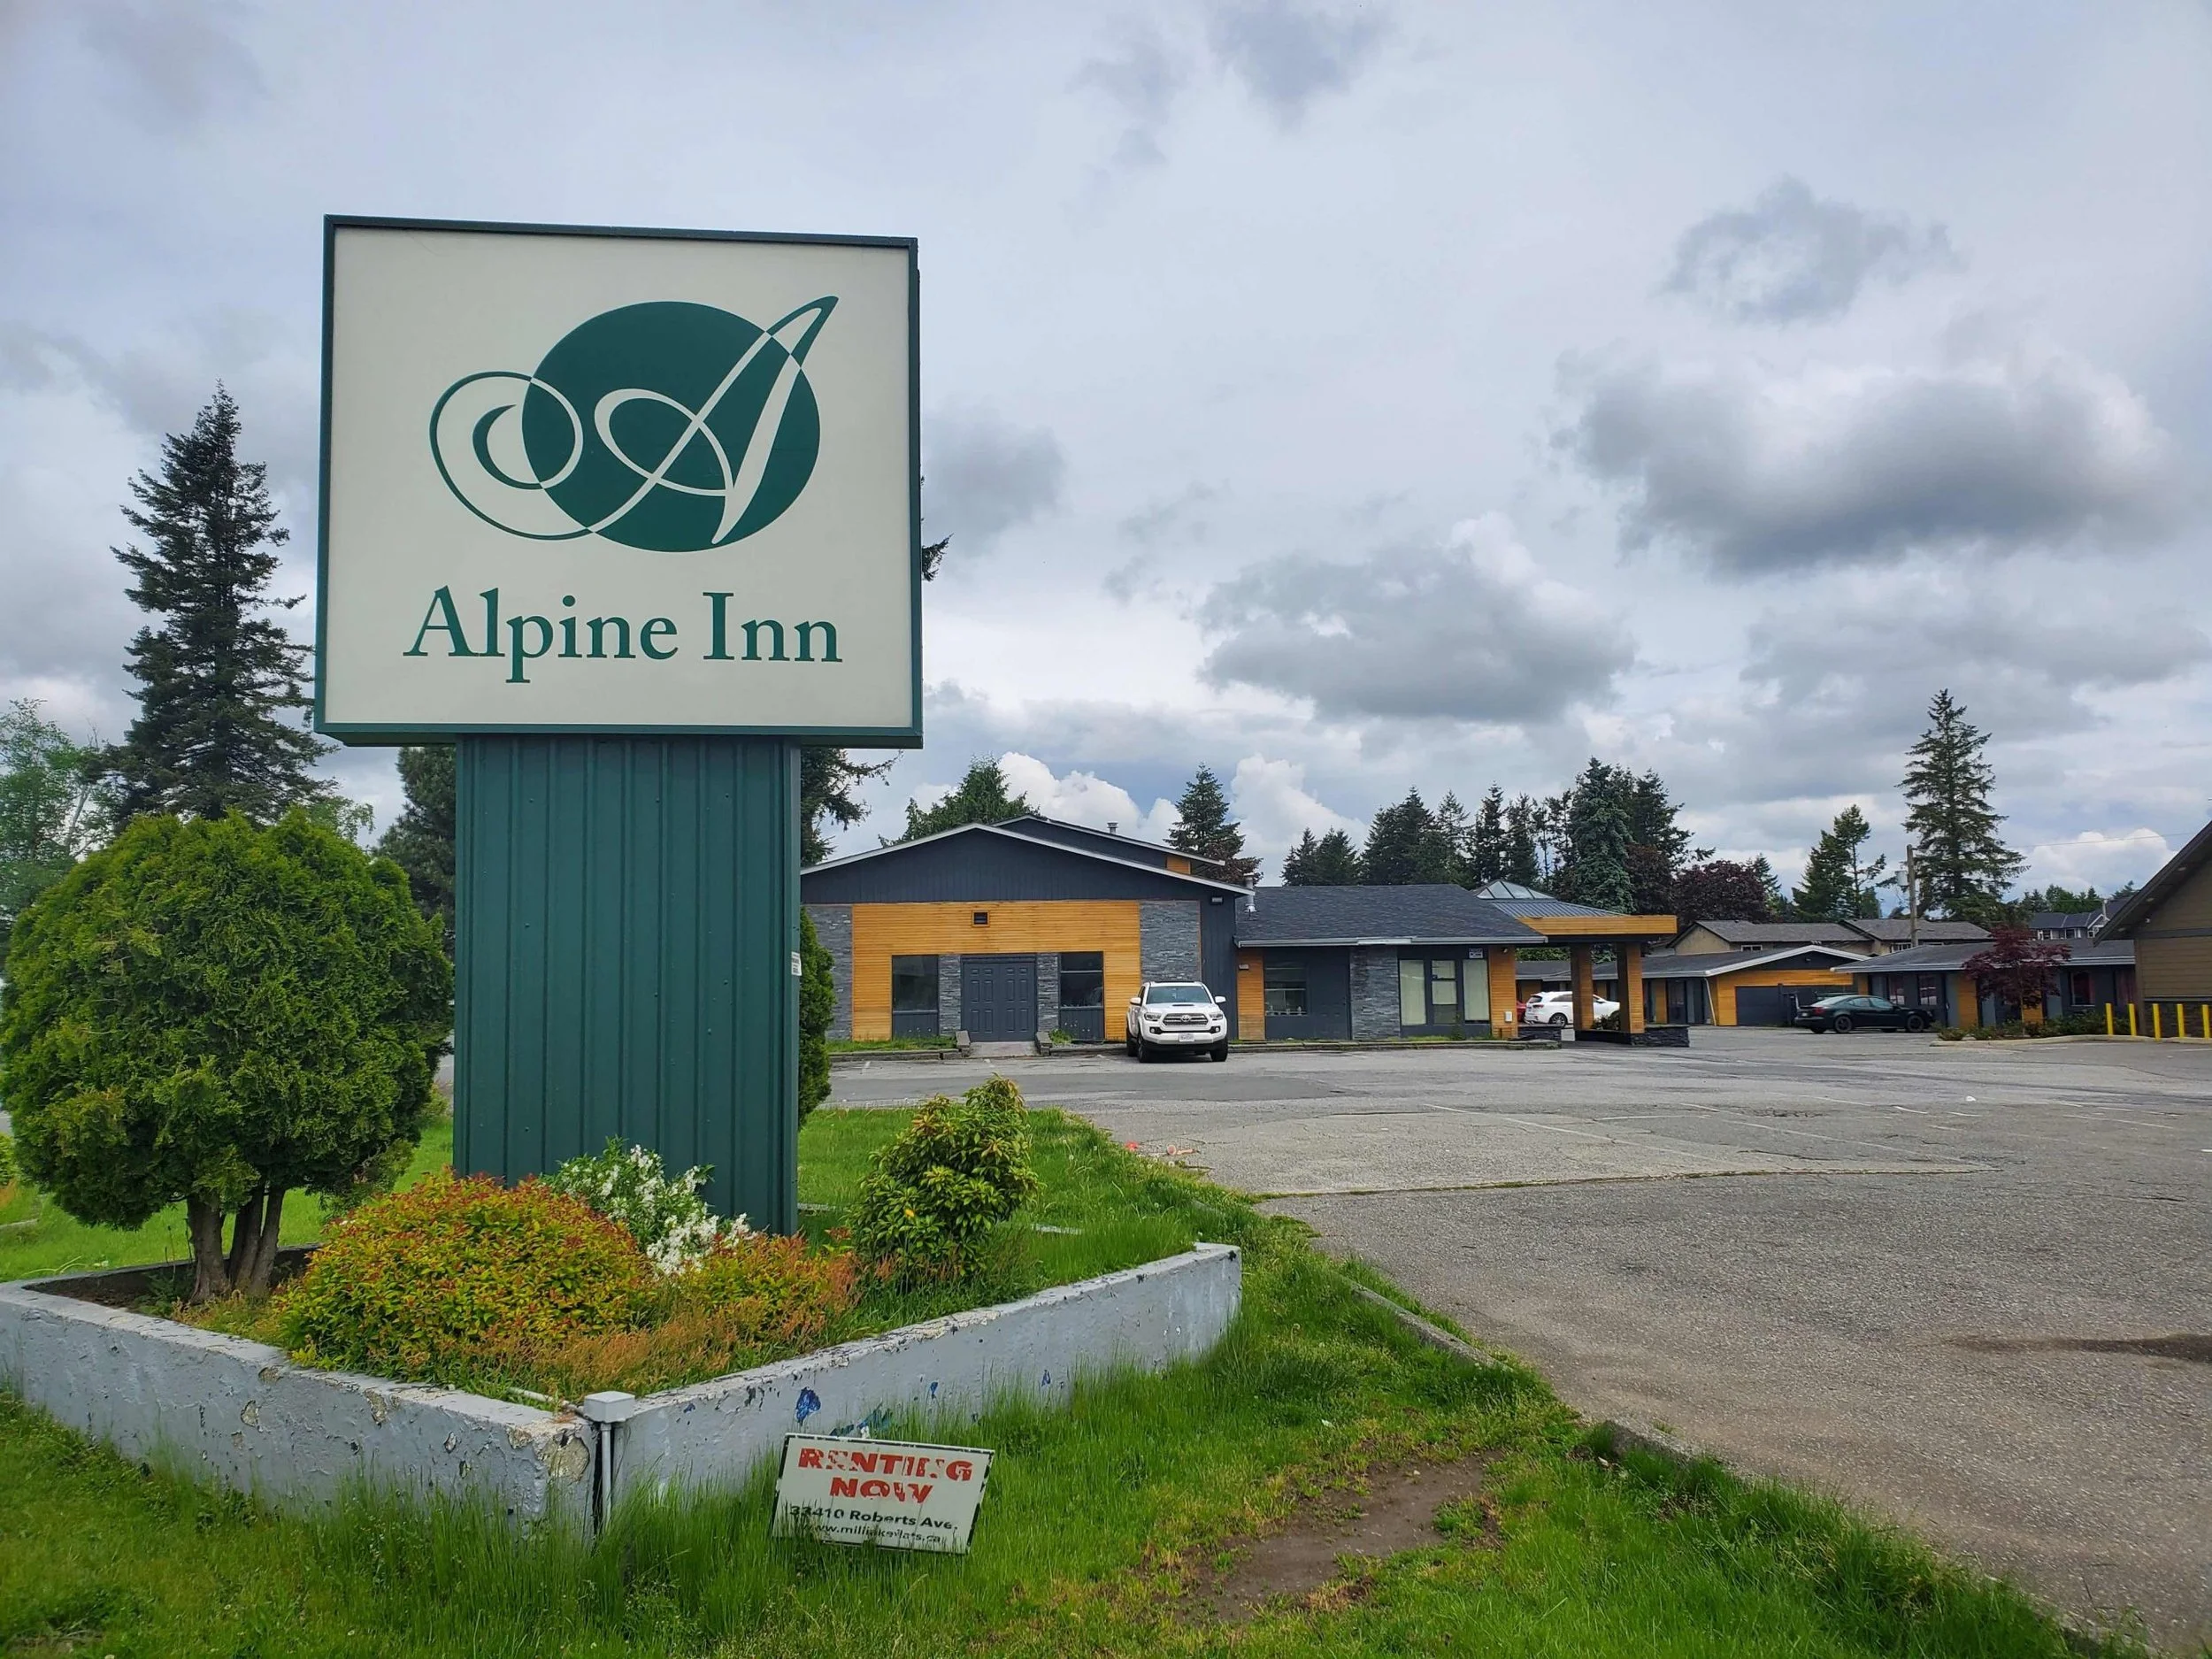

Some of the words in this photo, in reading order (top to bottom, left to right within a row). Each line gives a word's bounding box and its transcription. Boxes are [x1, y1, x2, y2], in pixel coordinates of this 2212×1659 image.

[403, 585, 679, 684] Alpine
[702, 591, 843, 663] Inn
[829, 1477, 933, 1503] NOW
[849, 1509, 917, 1526] Roberts
[920, 1517, 958, 1530] Ave.
